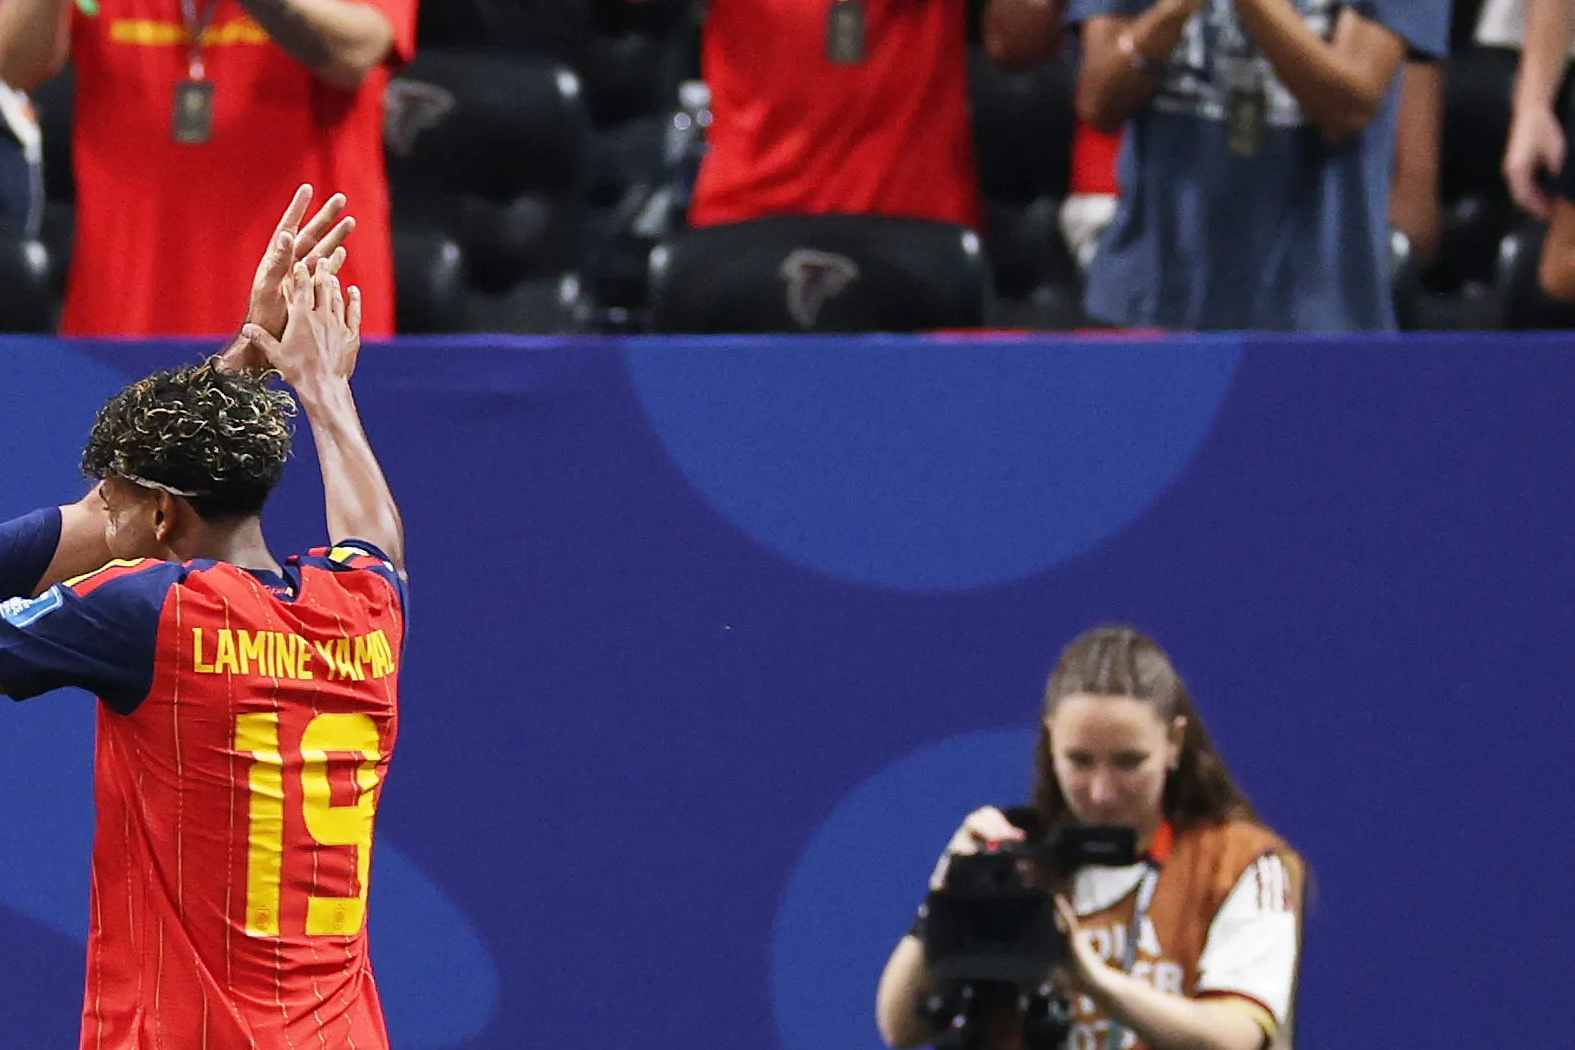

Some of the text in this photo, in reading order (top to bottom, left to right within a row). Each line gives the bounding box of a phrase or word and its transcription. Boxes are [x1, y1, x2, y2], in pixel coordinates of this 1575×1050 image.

[192, 627, 395, 681] LAMINE YAMAL
[234, 712, 382, 937] 19
